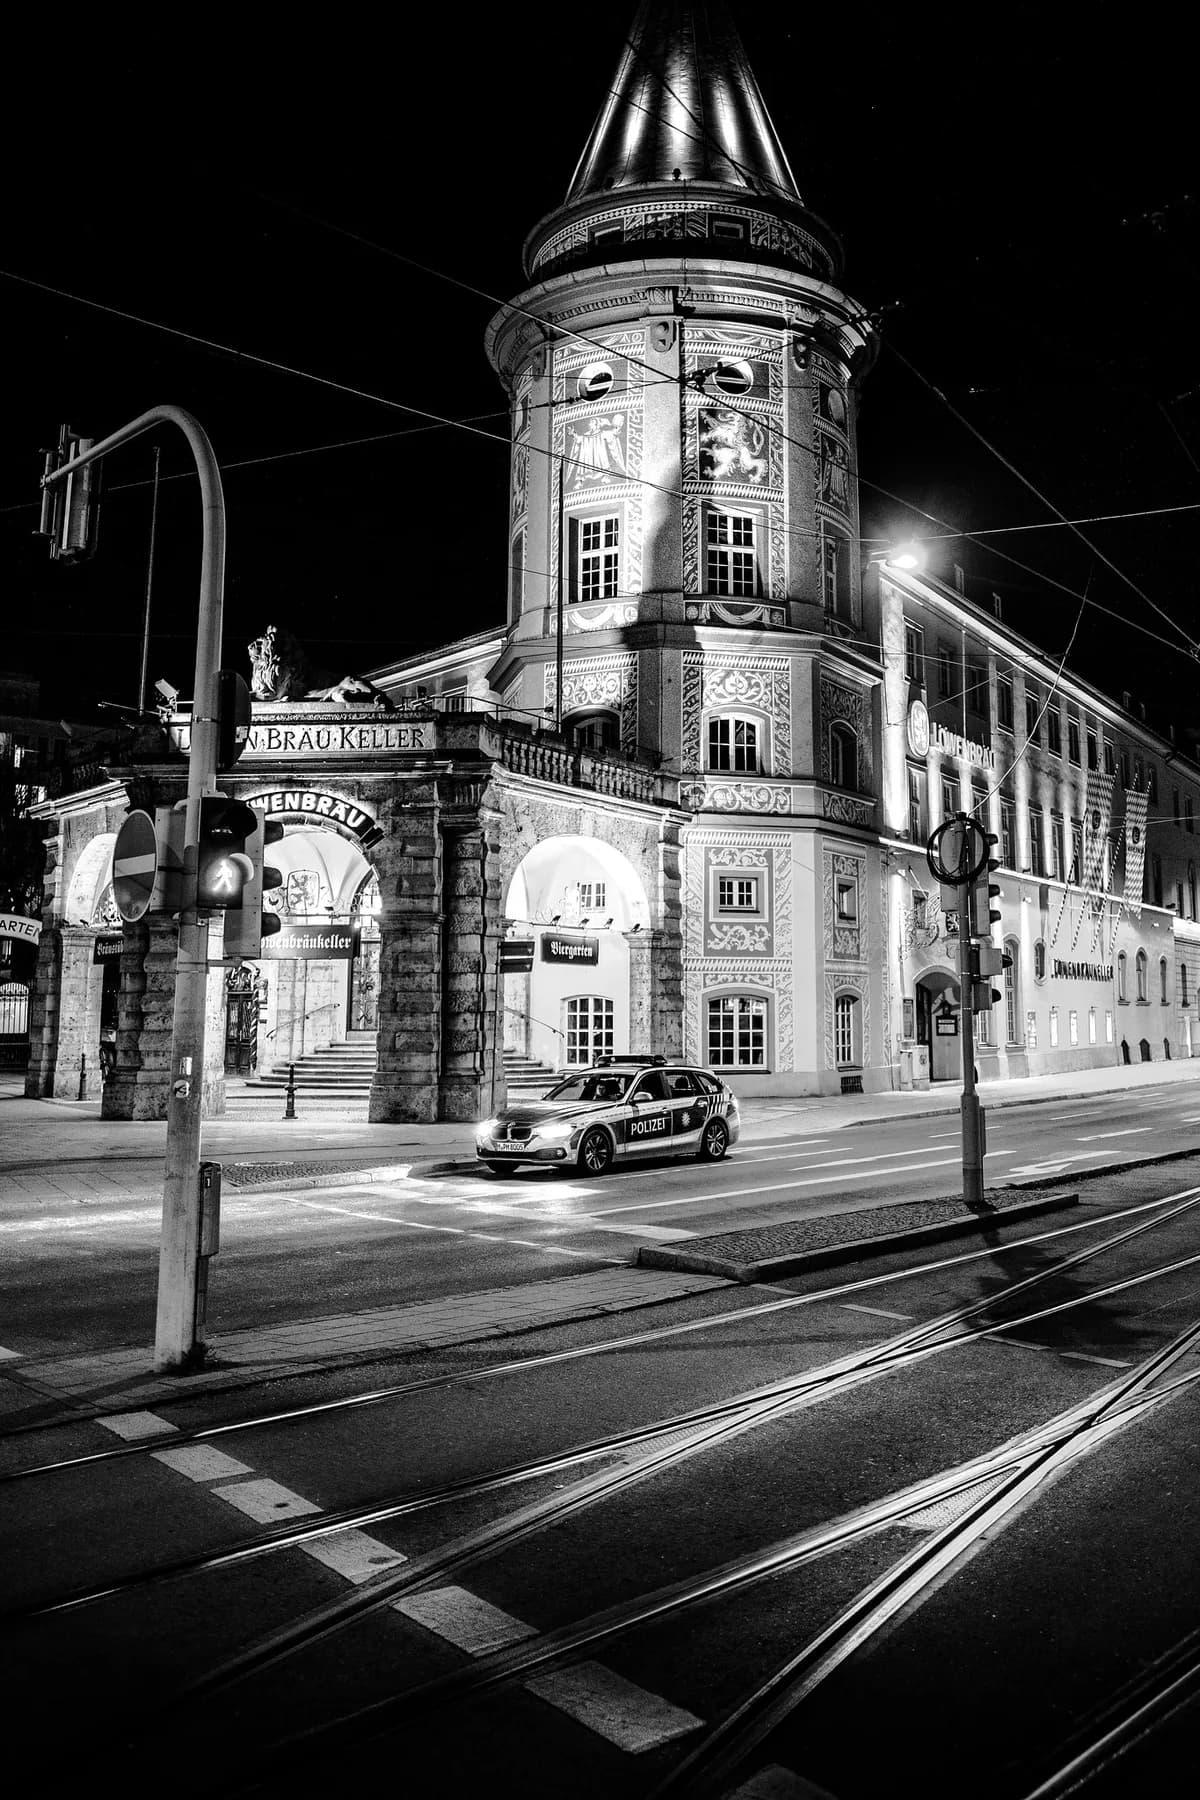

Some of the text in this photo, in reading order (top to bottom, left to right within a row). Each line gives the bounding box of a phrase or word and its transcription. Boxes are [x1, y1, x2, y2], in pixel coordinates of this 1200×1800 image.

[931, 722, 996, 769] LÖWENBRÄU
[246, 792, 366, 828] WENBRÄU
[551, 941, 592, 959] Biergarten
[631, 1118, 665, 1135] POLIZEI
